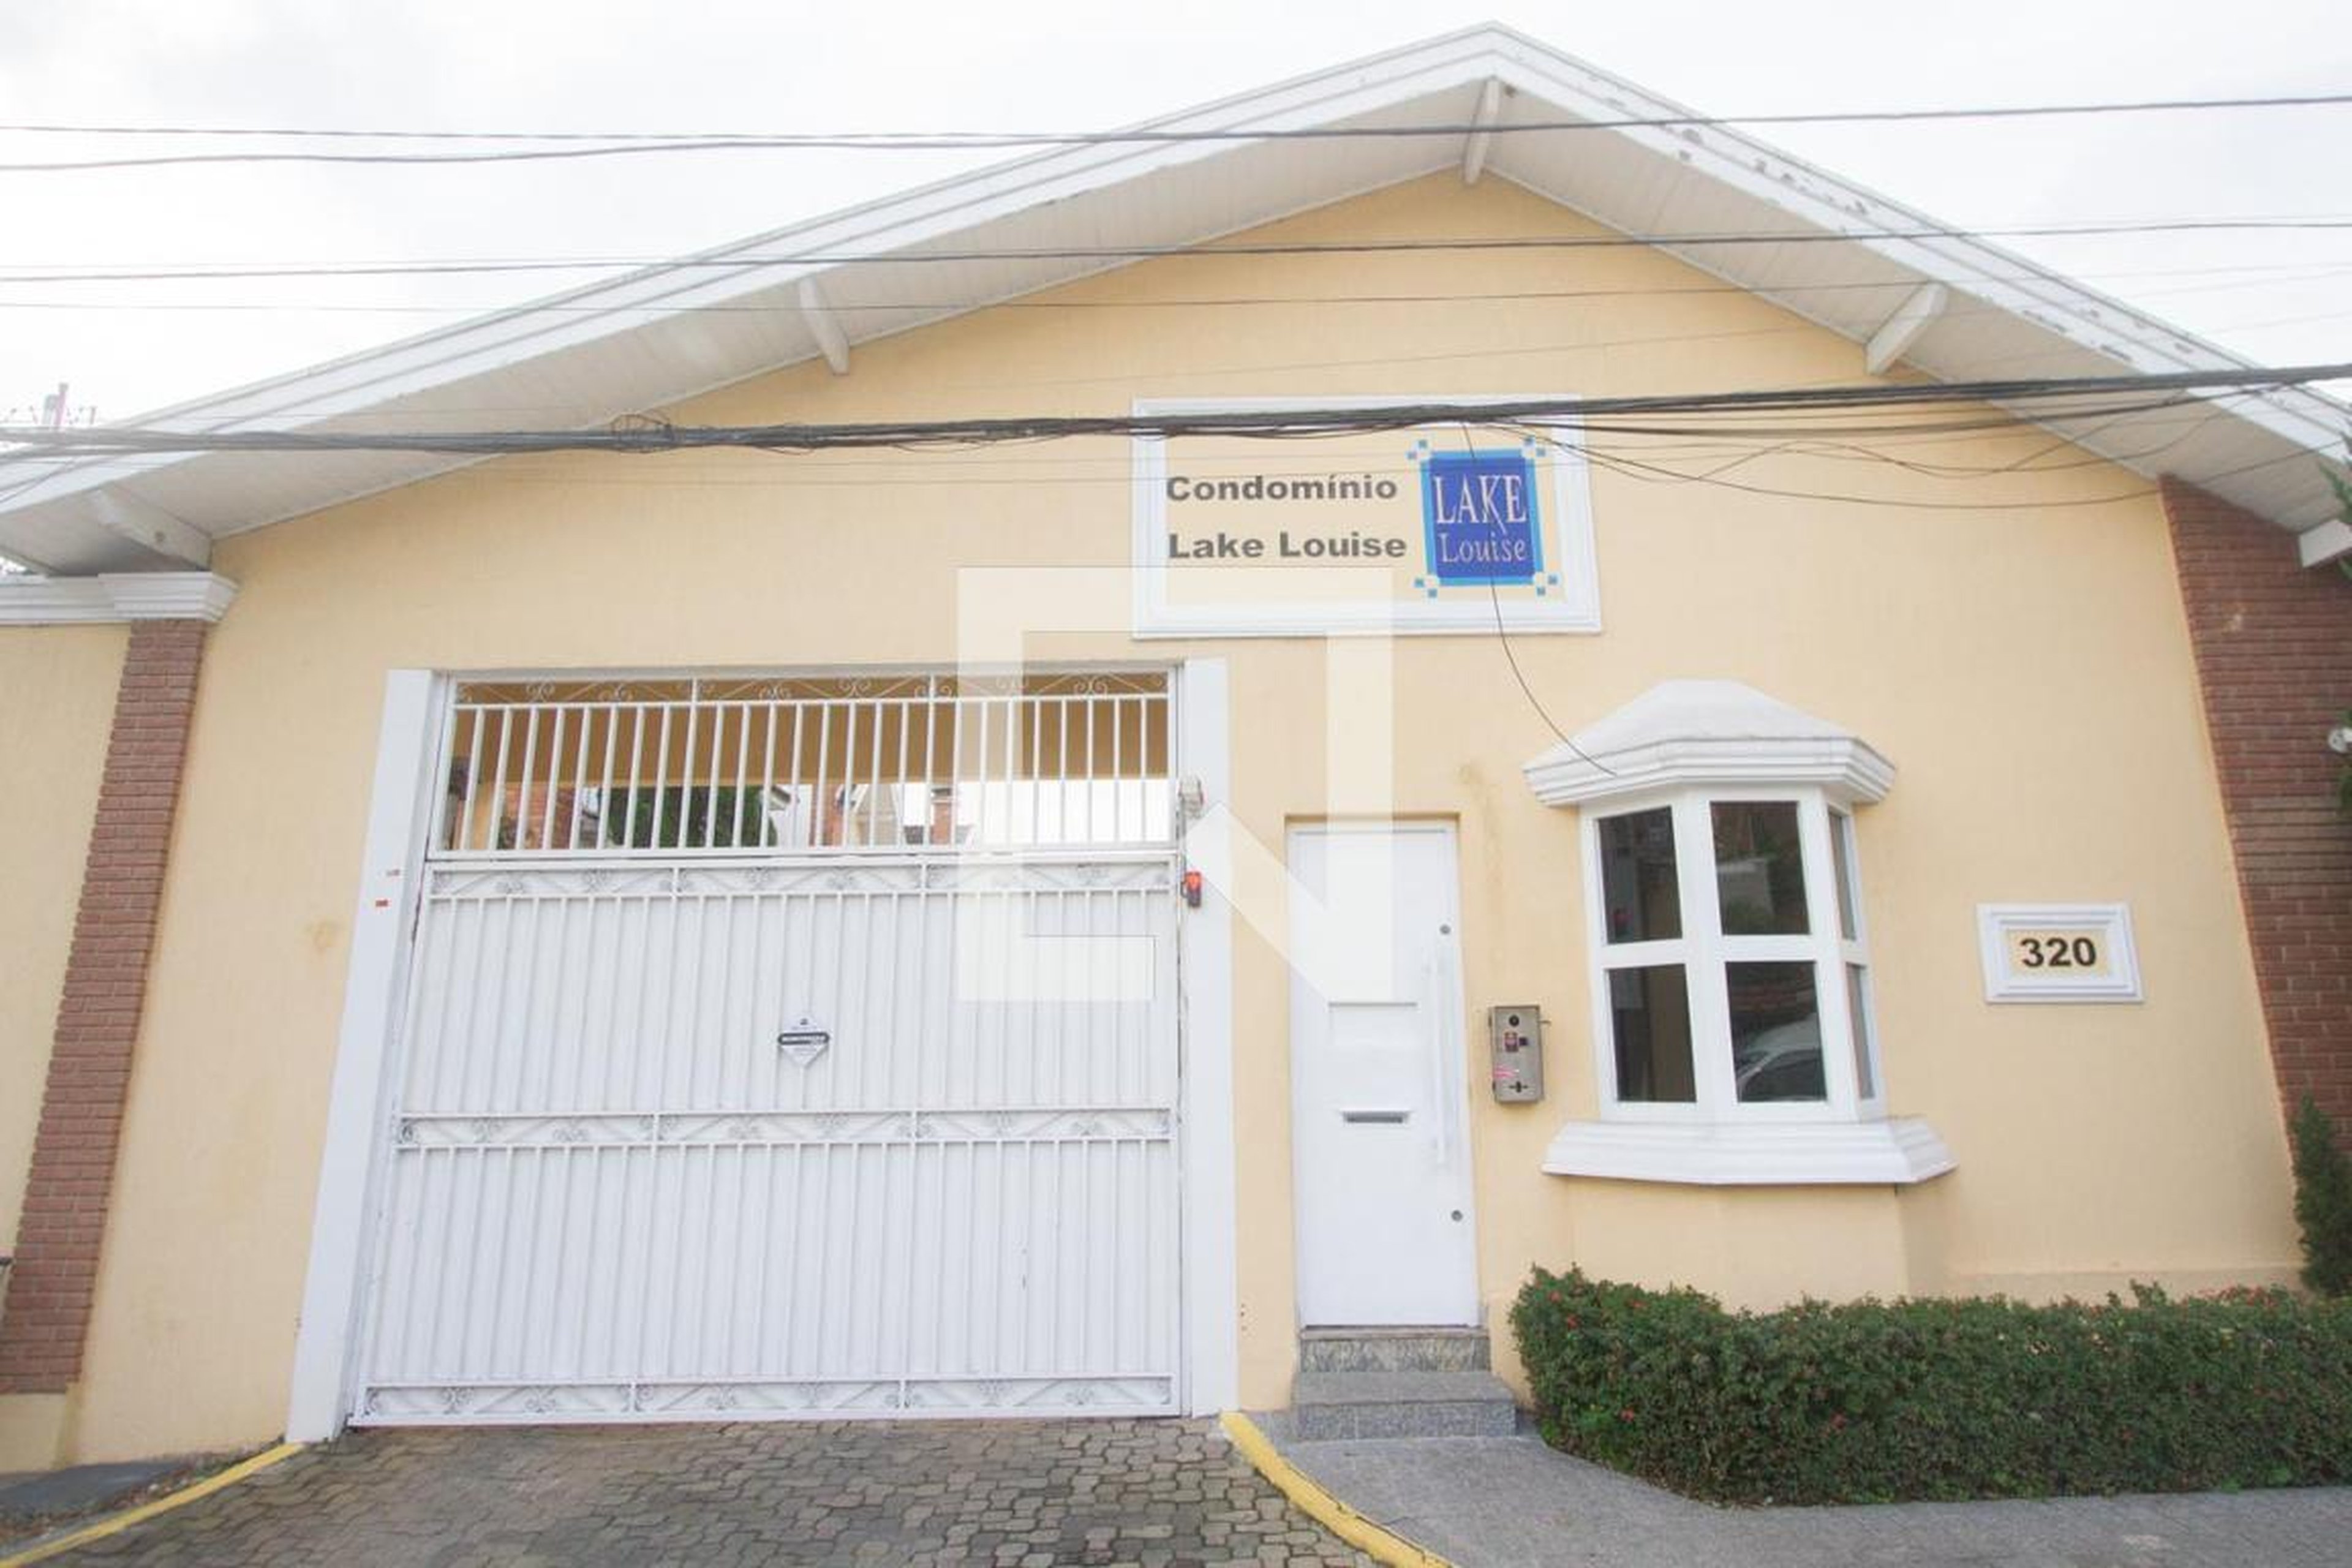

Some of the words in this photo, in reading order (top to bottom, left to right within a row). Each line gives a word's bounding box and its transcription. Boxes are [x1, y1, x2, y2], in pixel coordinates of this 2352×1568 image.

[1166, 474, 1397, 501] Condomínio
[1433, 474, 1527, 535] LAKE
[1169, 533, 1264, 559] Lake
[1279, 531, 1408, 557] Louise
[1439, 531, 1526, 563] Louise
[2020, 937, 2097, 968] 320
